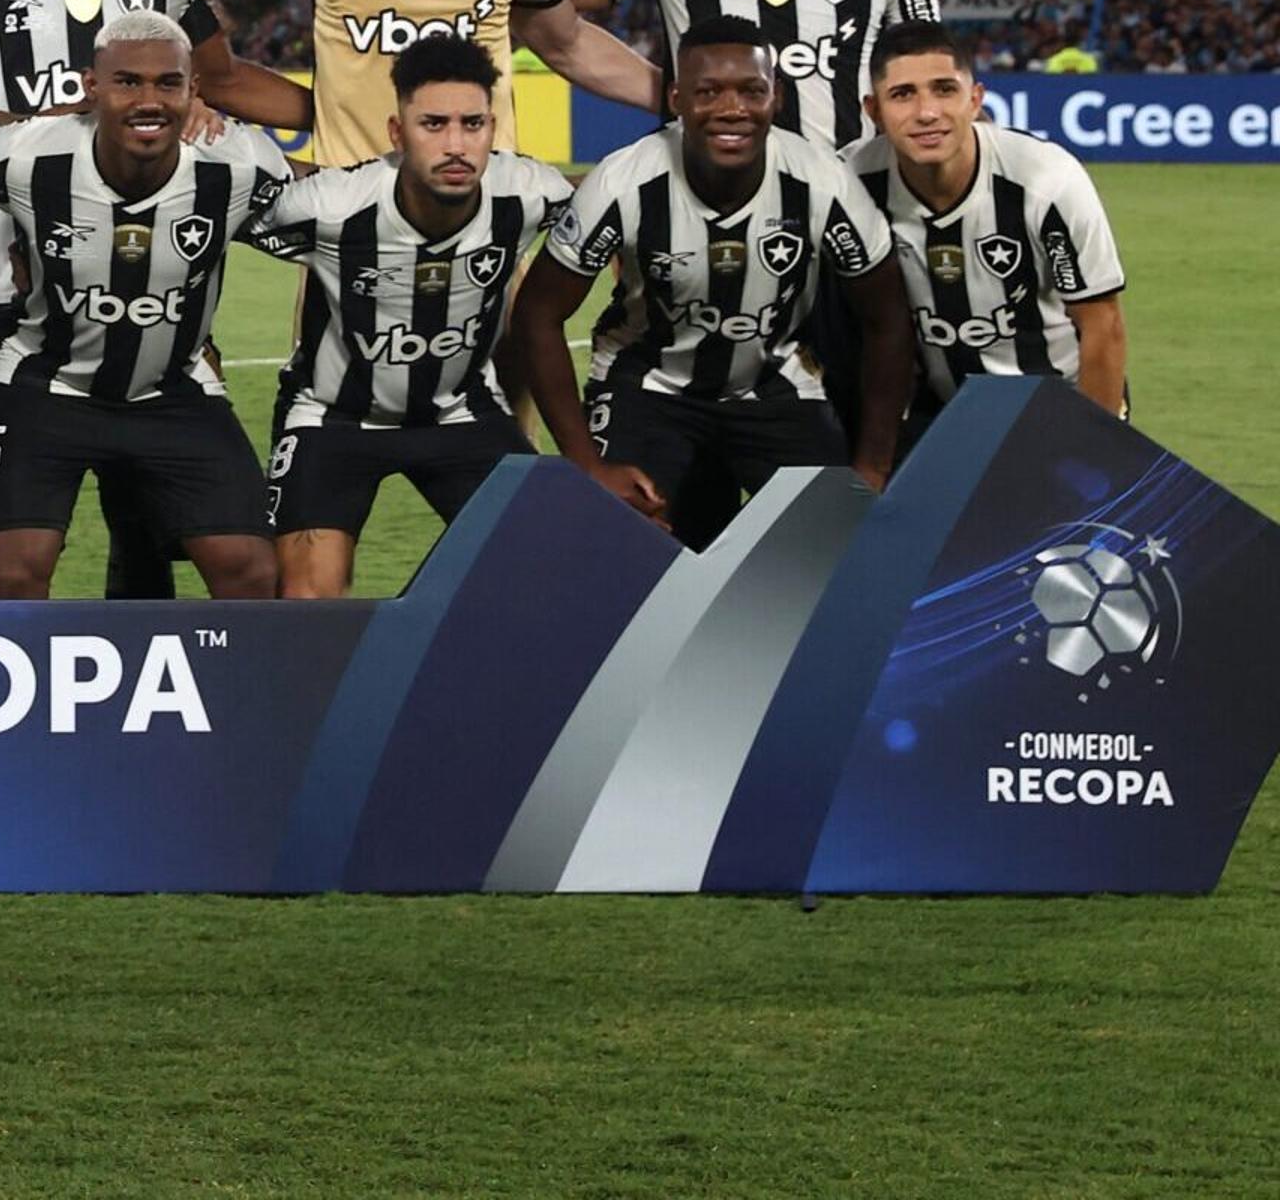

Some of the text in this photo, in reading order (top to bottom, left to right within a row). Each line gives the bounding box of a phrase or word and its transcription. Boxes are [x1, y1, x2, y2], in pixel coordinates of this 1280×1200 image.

[1060, 90, 1214, 147] Cree
[55, 285, 185, 325] vbet
[354, 317, 482, 362] vbet
[915, 306, 1017, 348] bet
[987, 767, 1175, 807] RECOPA
